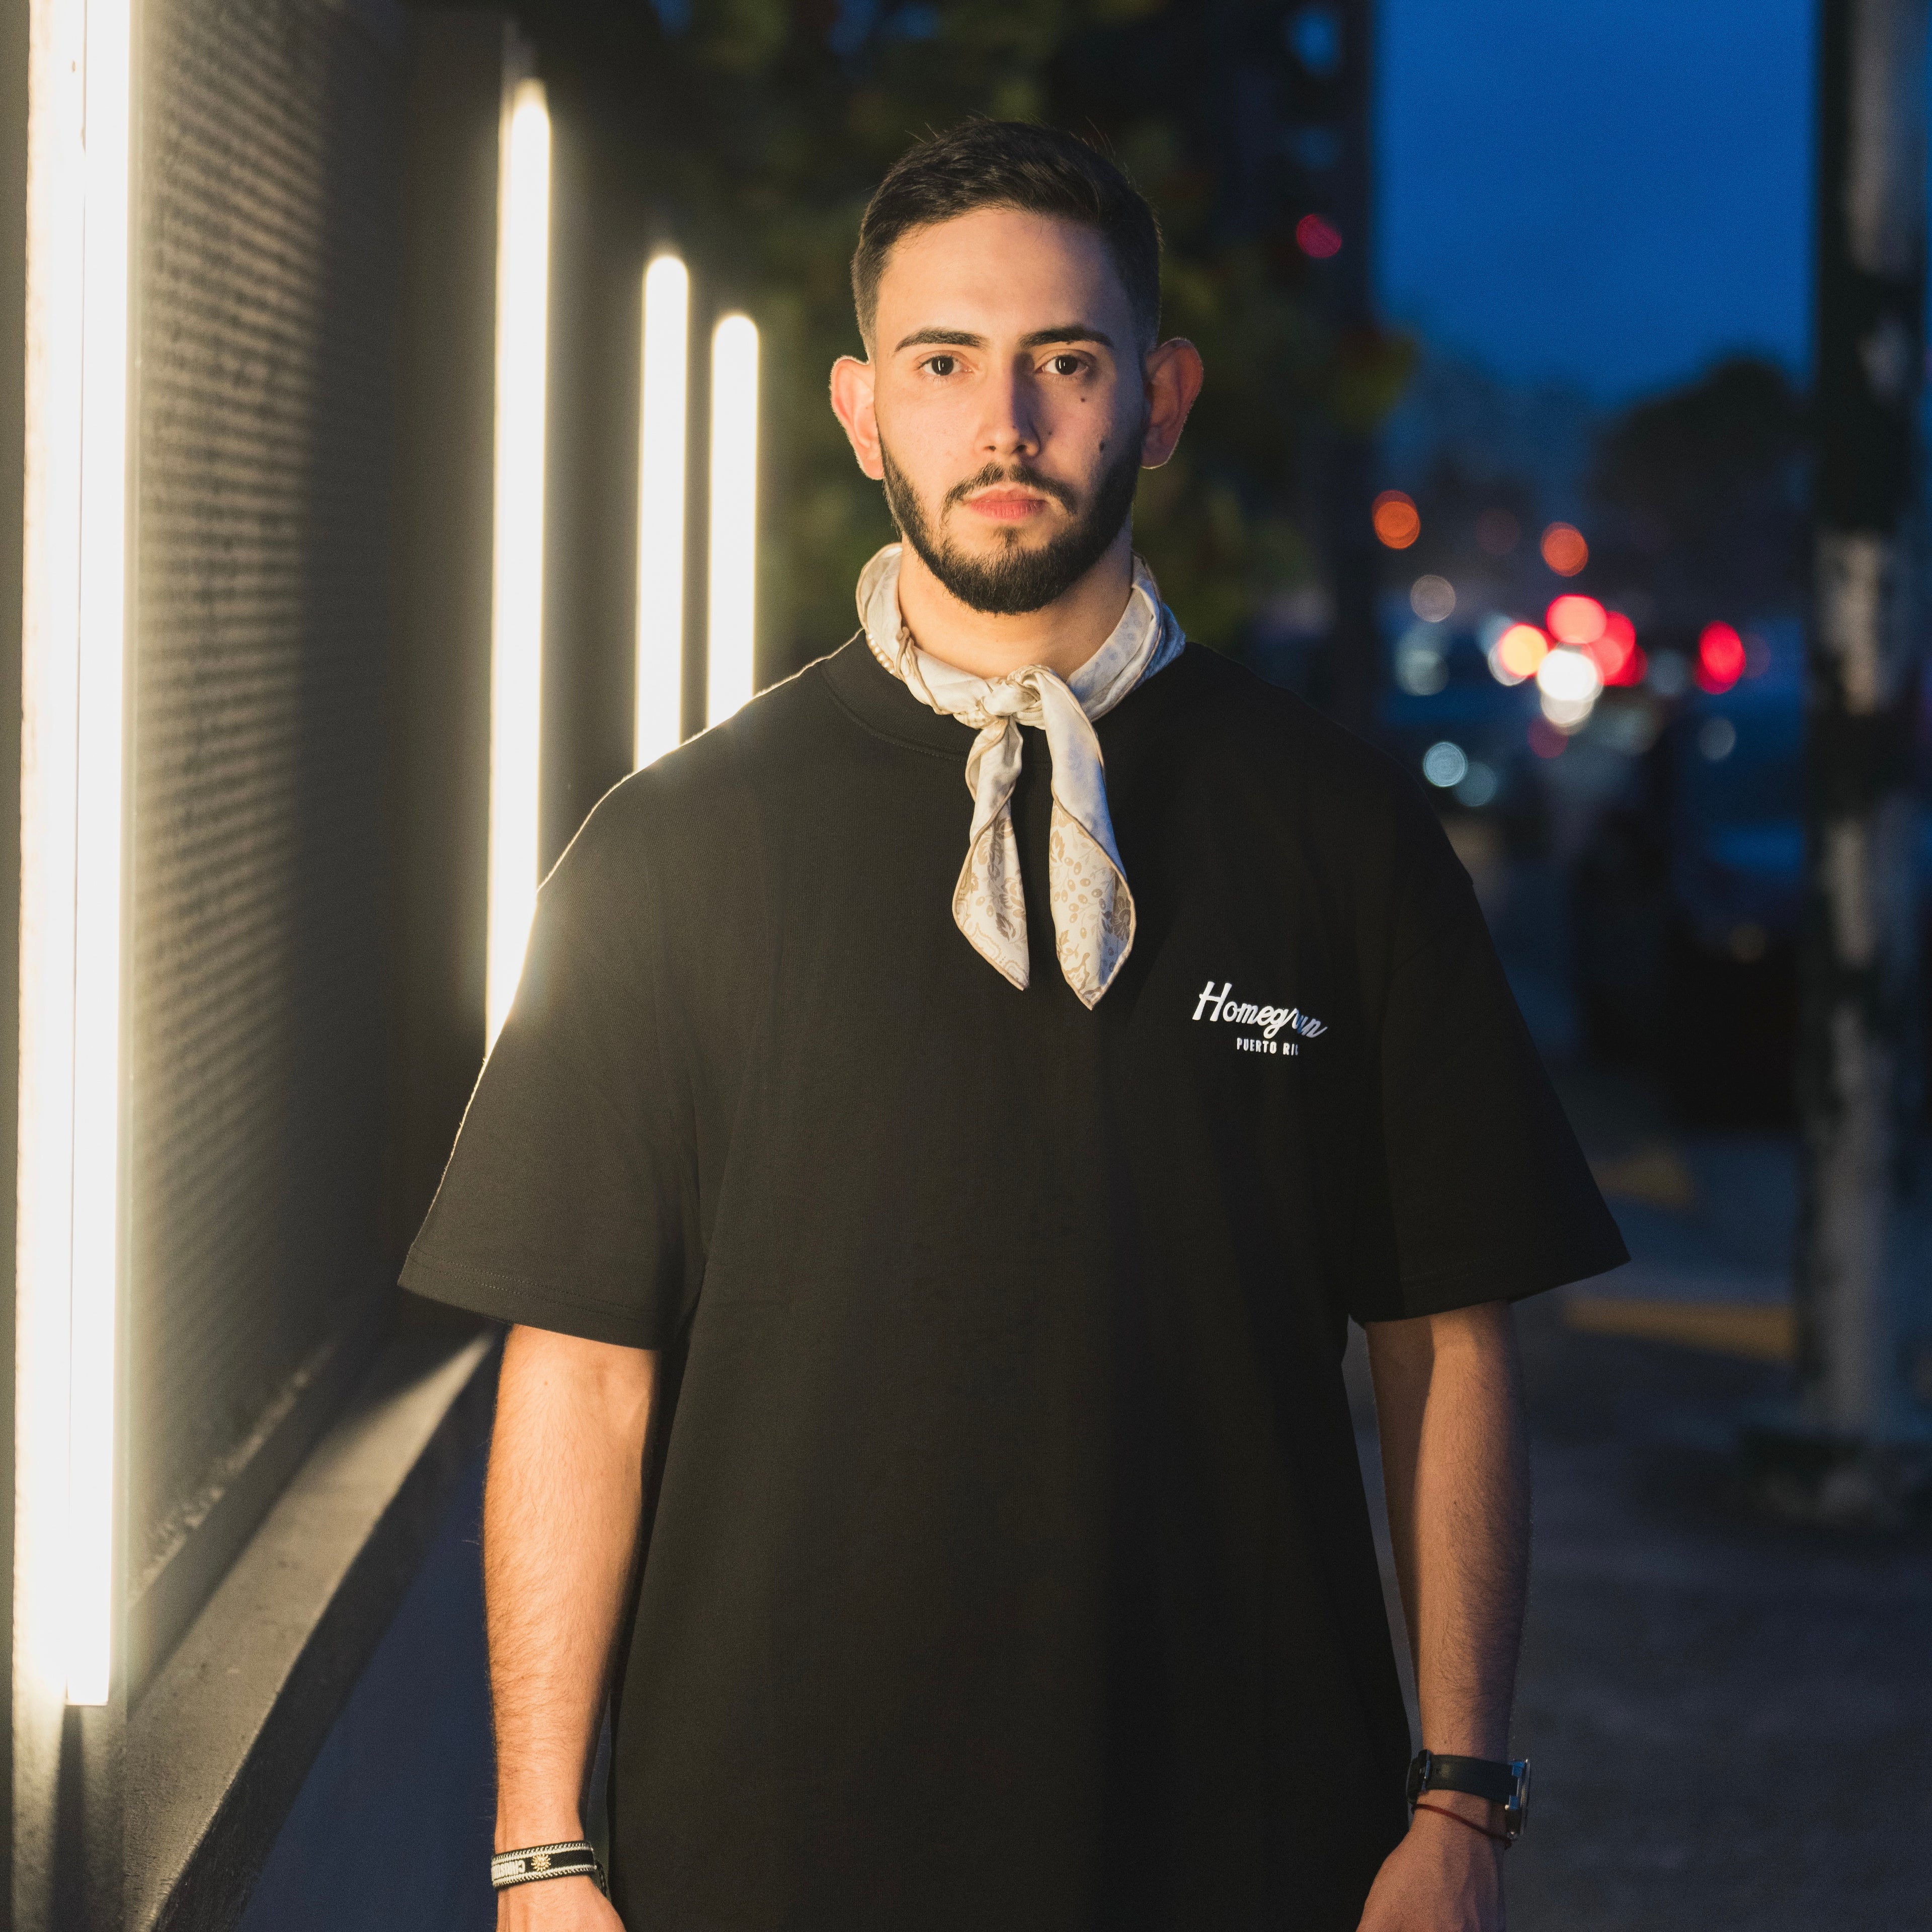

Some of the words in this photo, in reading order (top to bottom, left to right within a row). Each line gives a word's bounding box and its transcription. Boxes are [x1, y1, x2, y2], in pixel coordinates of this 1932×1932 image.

[1192, 981, 1328, 1039] Homegrn
[1236, 1037, 1277, 1055] PUERTO
[1282, 1042, 1299, 1056] RI
